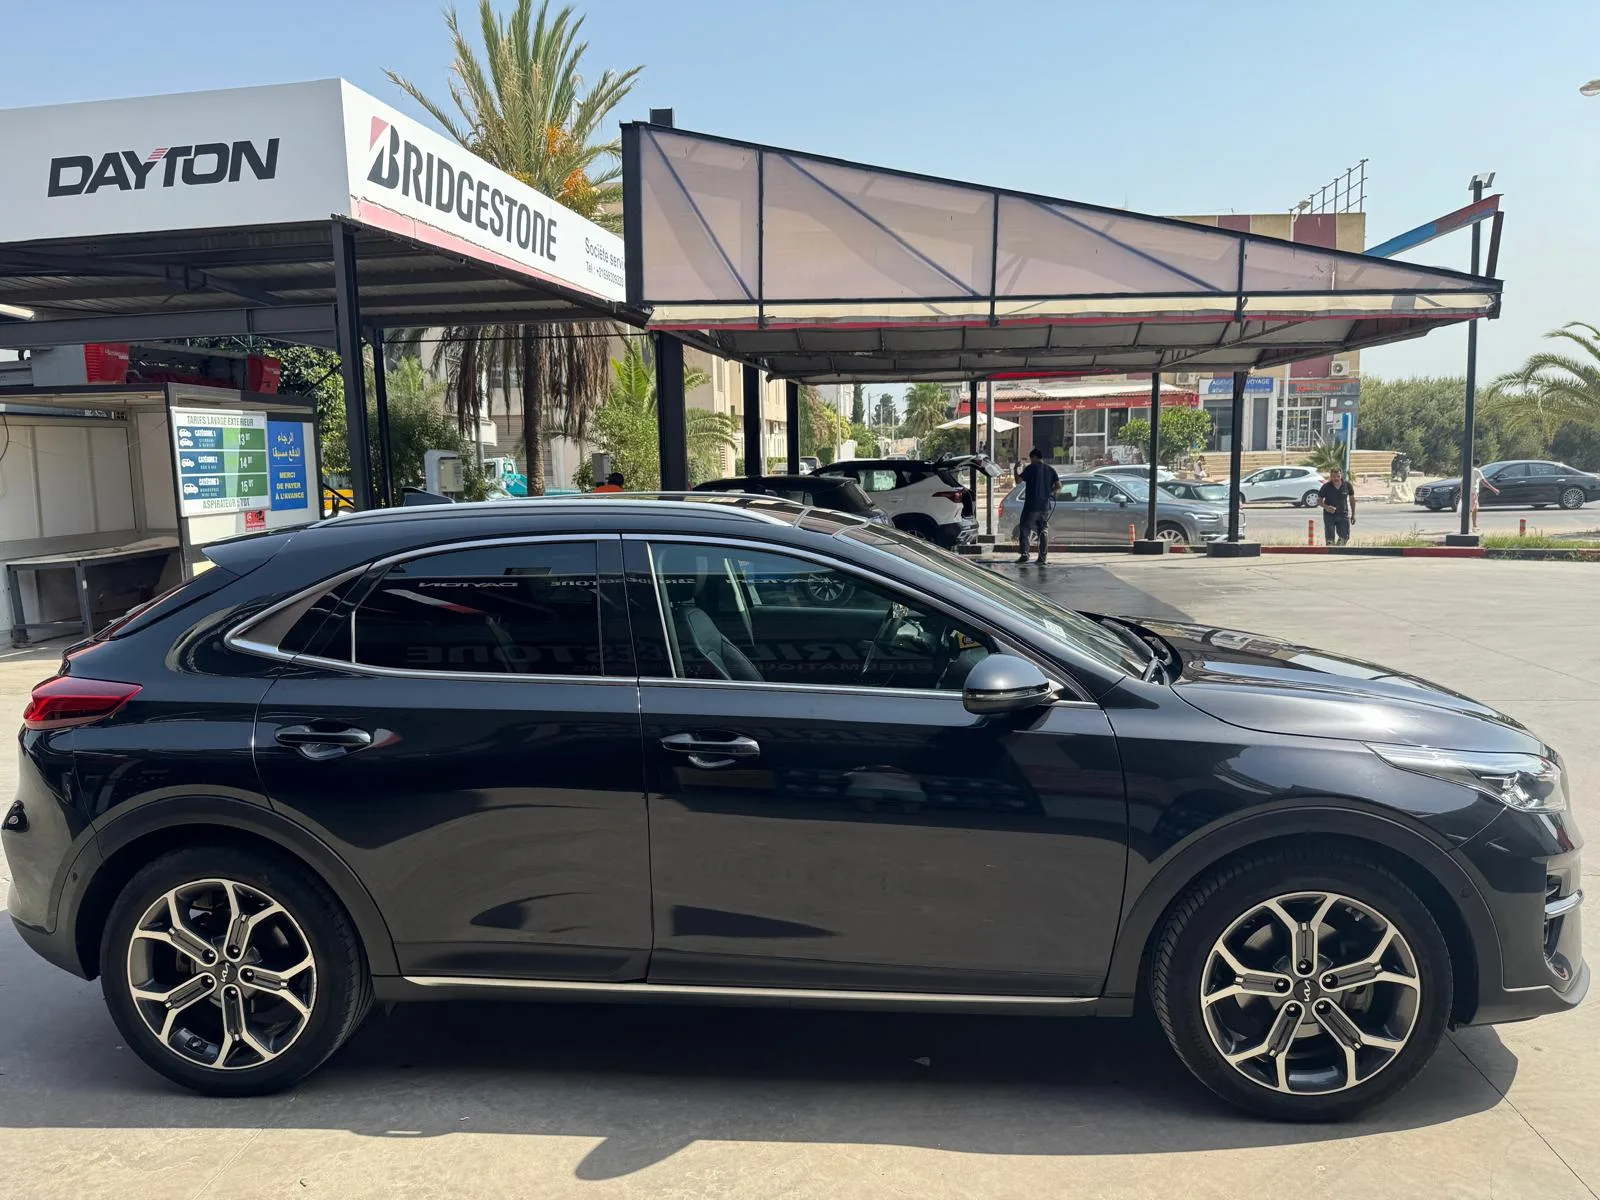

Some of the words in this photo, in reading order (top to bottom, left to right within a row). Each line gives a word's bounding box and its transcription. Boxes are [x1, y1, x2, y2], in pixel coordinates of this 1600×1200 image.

[48, 138, 280, 197] DAYTON
[366, 115, 558, 262] BRIDGESTONE
[187, 415, 206, 425] TARIFS
[207, 416, 227, 426] LAVAGE
[240, 457, 248, 469] 14
[279, 471, 296, 479] MERCI
[241, 480, 249, 493] 15
[276, 482, 284, 490] DE
[284, 482, 301, 490] PAYER
